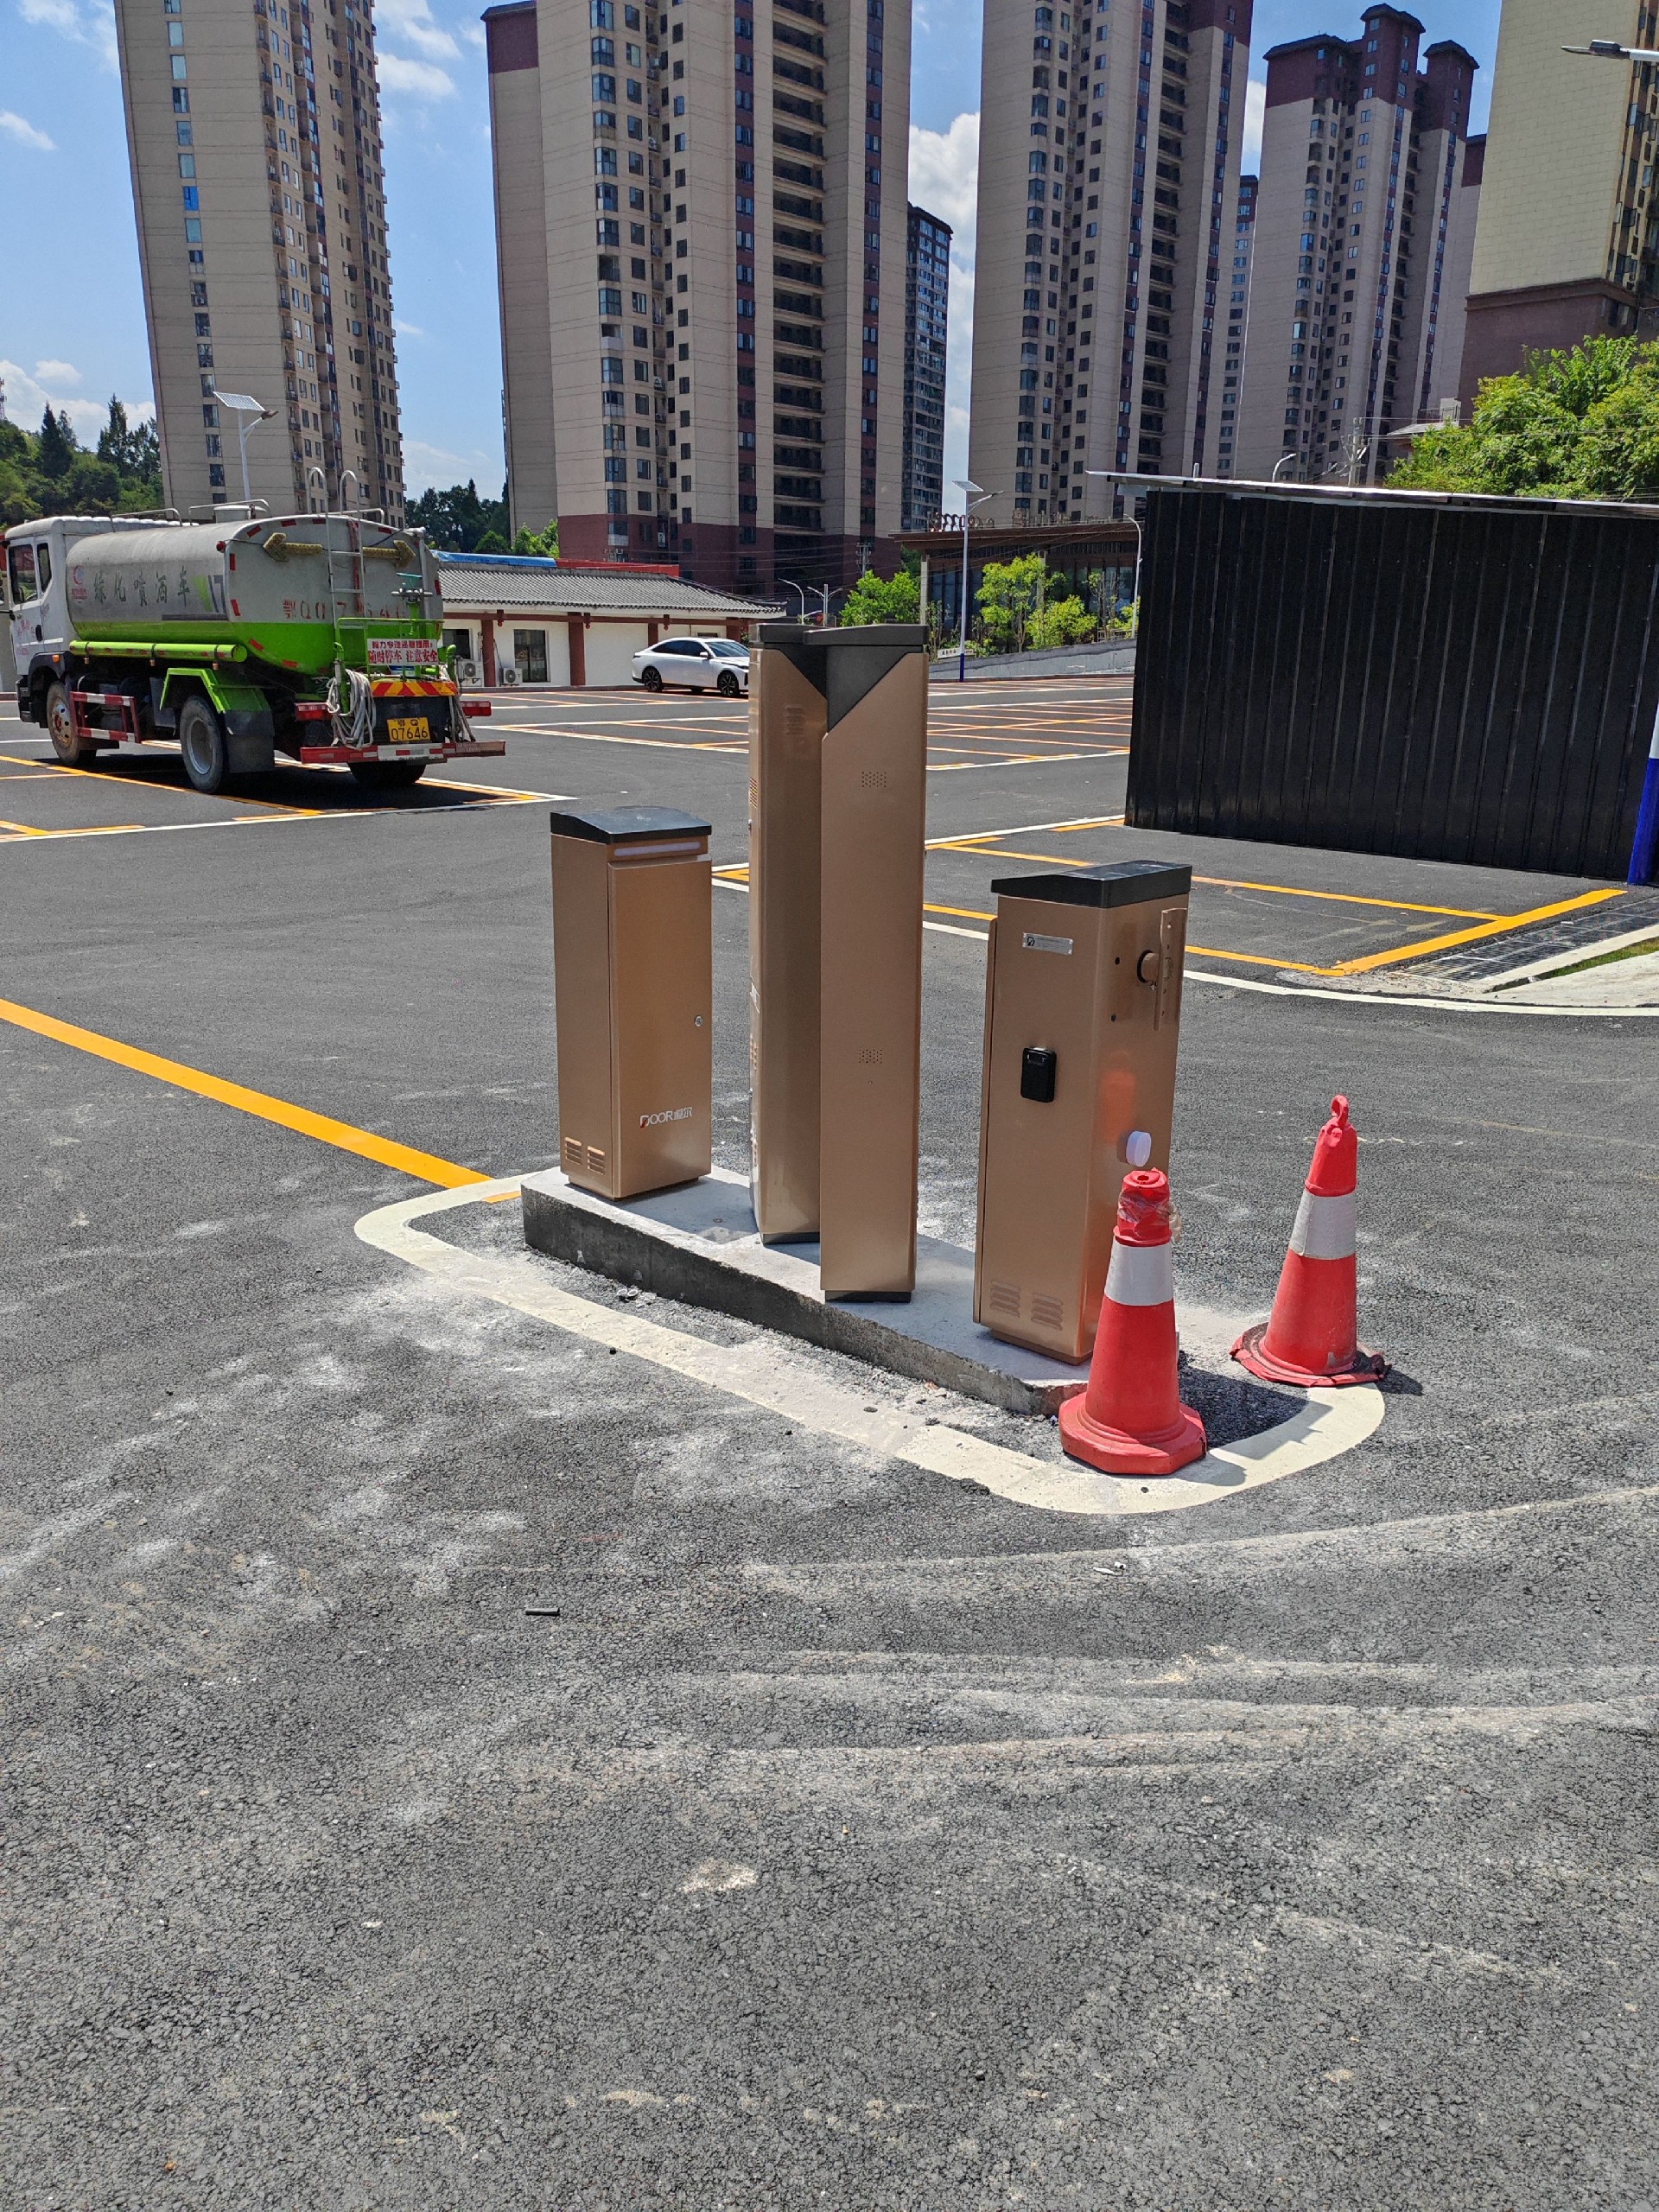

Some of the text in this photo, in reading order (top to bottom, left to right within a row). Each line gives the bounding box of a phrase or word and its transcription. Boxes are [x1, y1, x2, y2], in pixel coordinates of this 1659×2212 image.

[93, 564, 191, 607] 绿化喷洒车
[368, 650, 438, 664] 随时停车 注意安全
[391, 727, 429, 741] 07646
